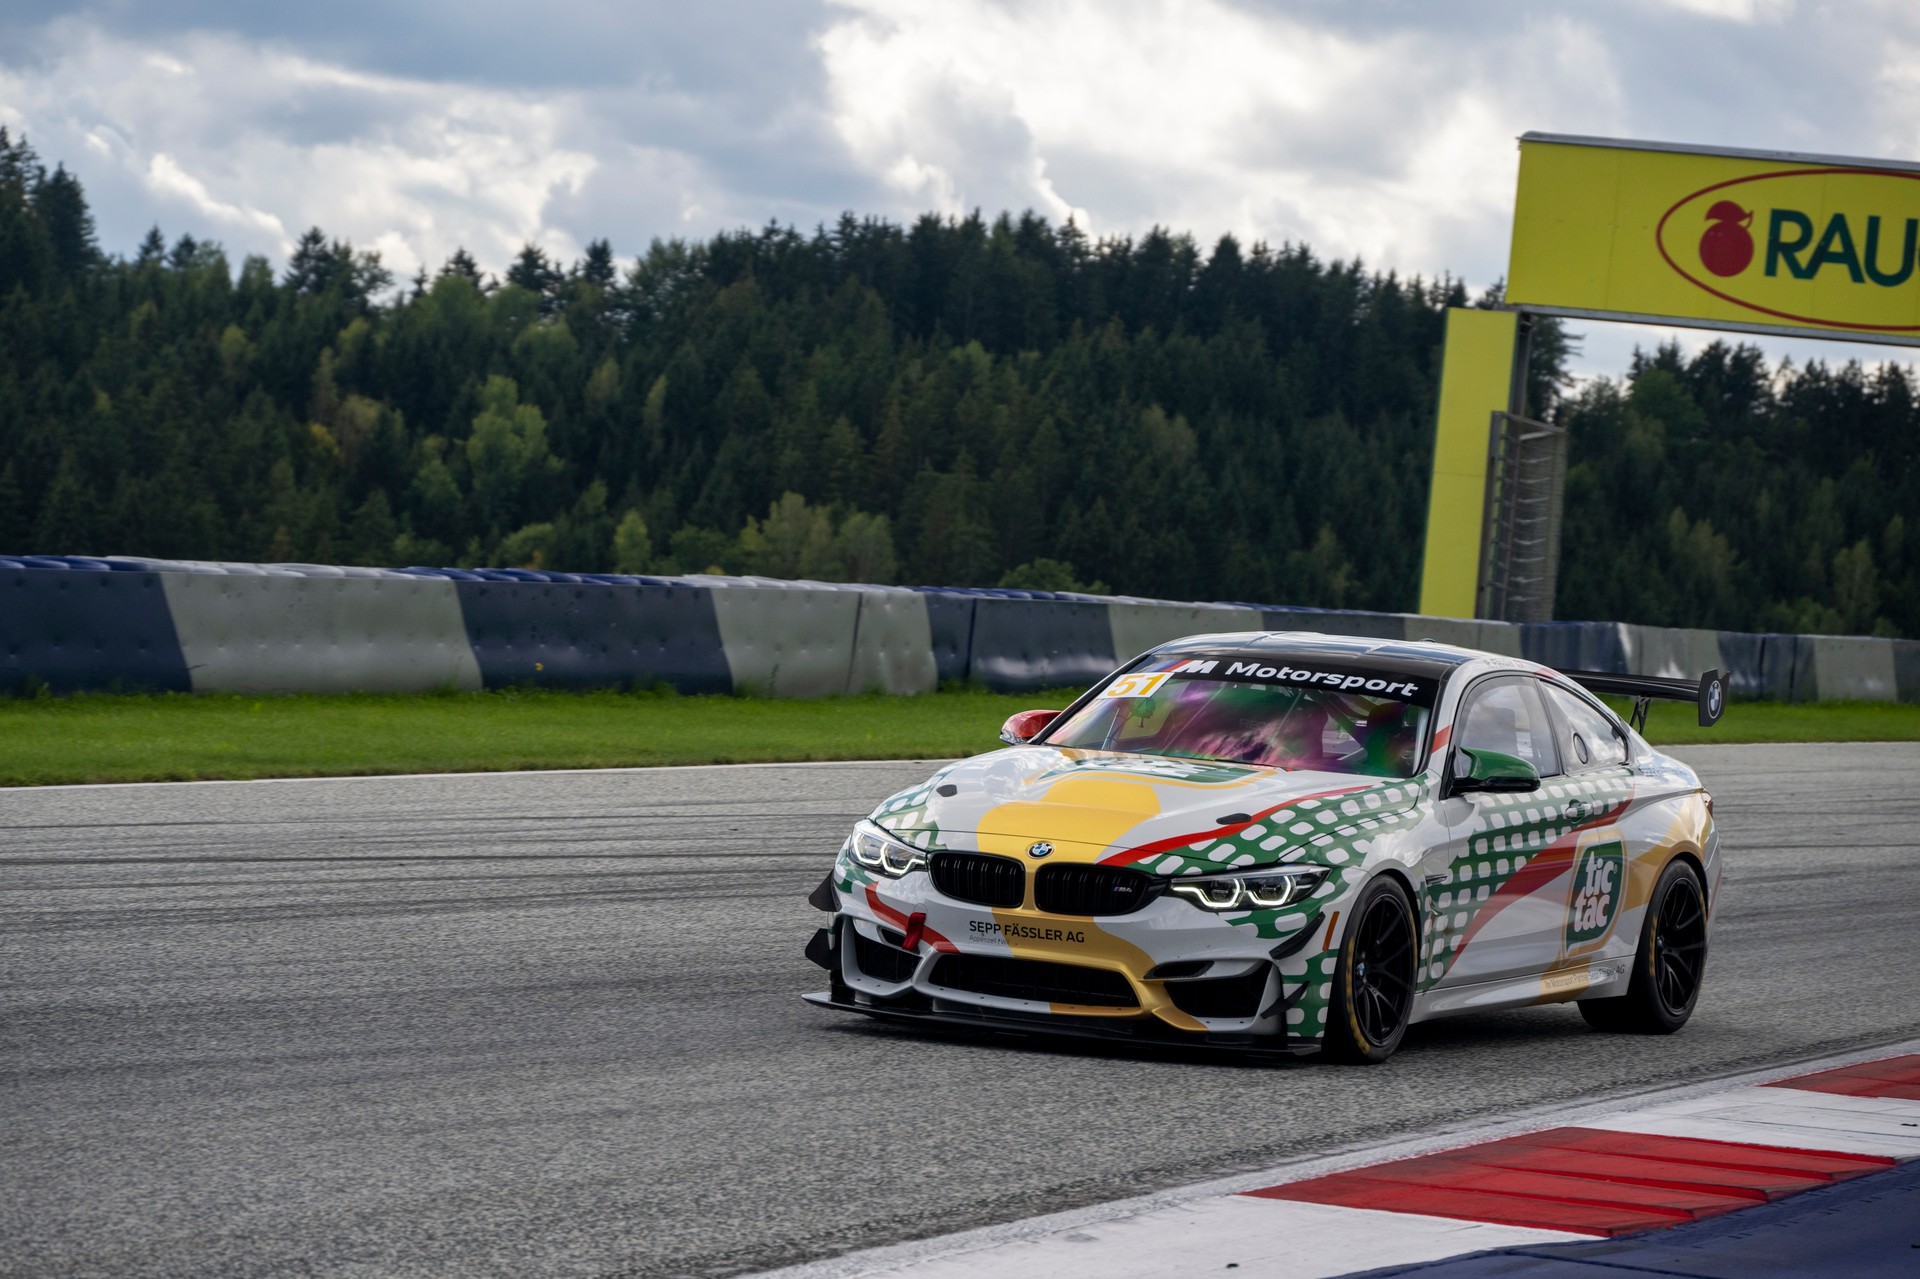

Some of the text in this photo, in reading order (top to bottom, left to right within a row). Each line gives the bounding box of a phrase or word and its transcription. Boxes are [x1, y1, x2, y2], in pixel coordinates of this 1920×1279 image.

[1764, 208, 1920, 287] RAU
[1107, 674, 1166, 697] 51
[1171, 660, 1419, 696] M Motorsport
[1586, 851, 1614, 898] tic
[1574, 886, 1610, 932] tac
[969, 920, 1001, 934] SEPP
[1004, 923, 1063, 942] FÄSSLER
[1066, 931, 1085, 943] AG
[1616, 964, 1626, 974] AG
